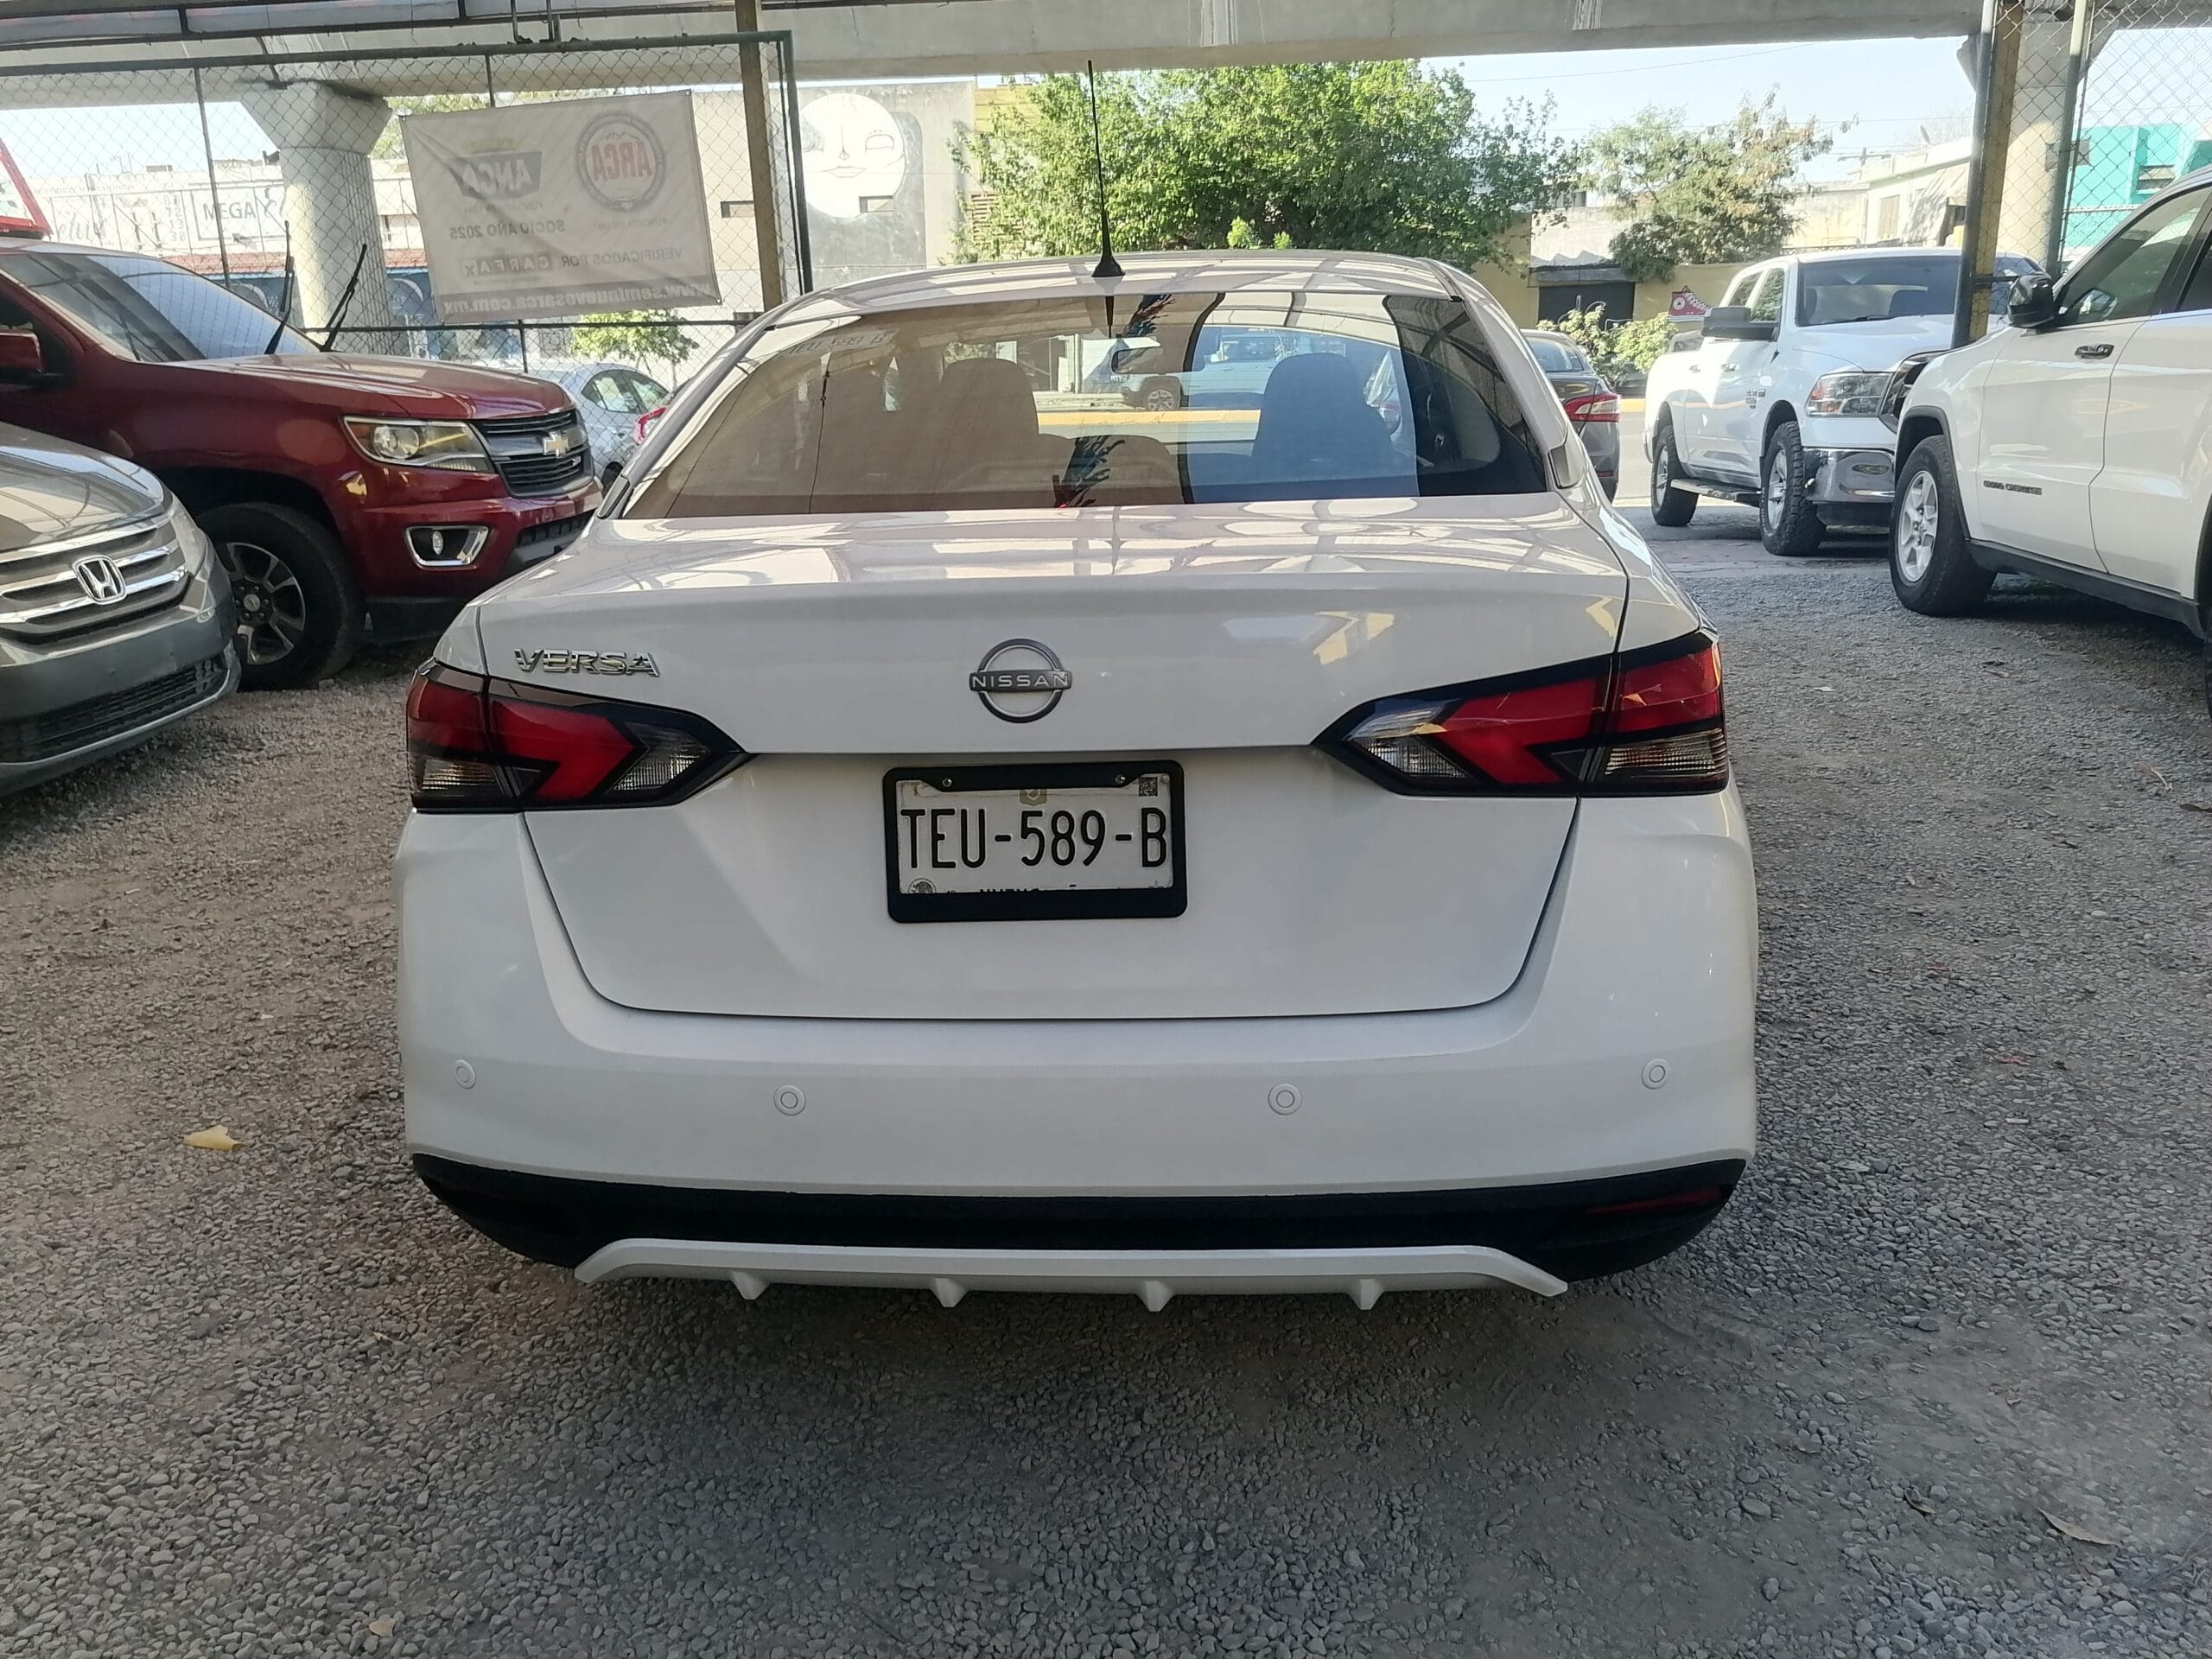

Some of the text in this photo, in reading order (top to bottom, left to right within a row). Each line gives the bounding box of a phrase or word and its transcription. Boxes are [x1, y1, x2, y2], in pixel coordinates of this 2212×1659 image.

[514, 649, 660, 677] VERSA
[972, 674, 1068, 688] NISSAN
[900, 807, 1167, 868] TEU-589-B
